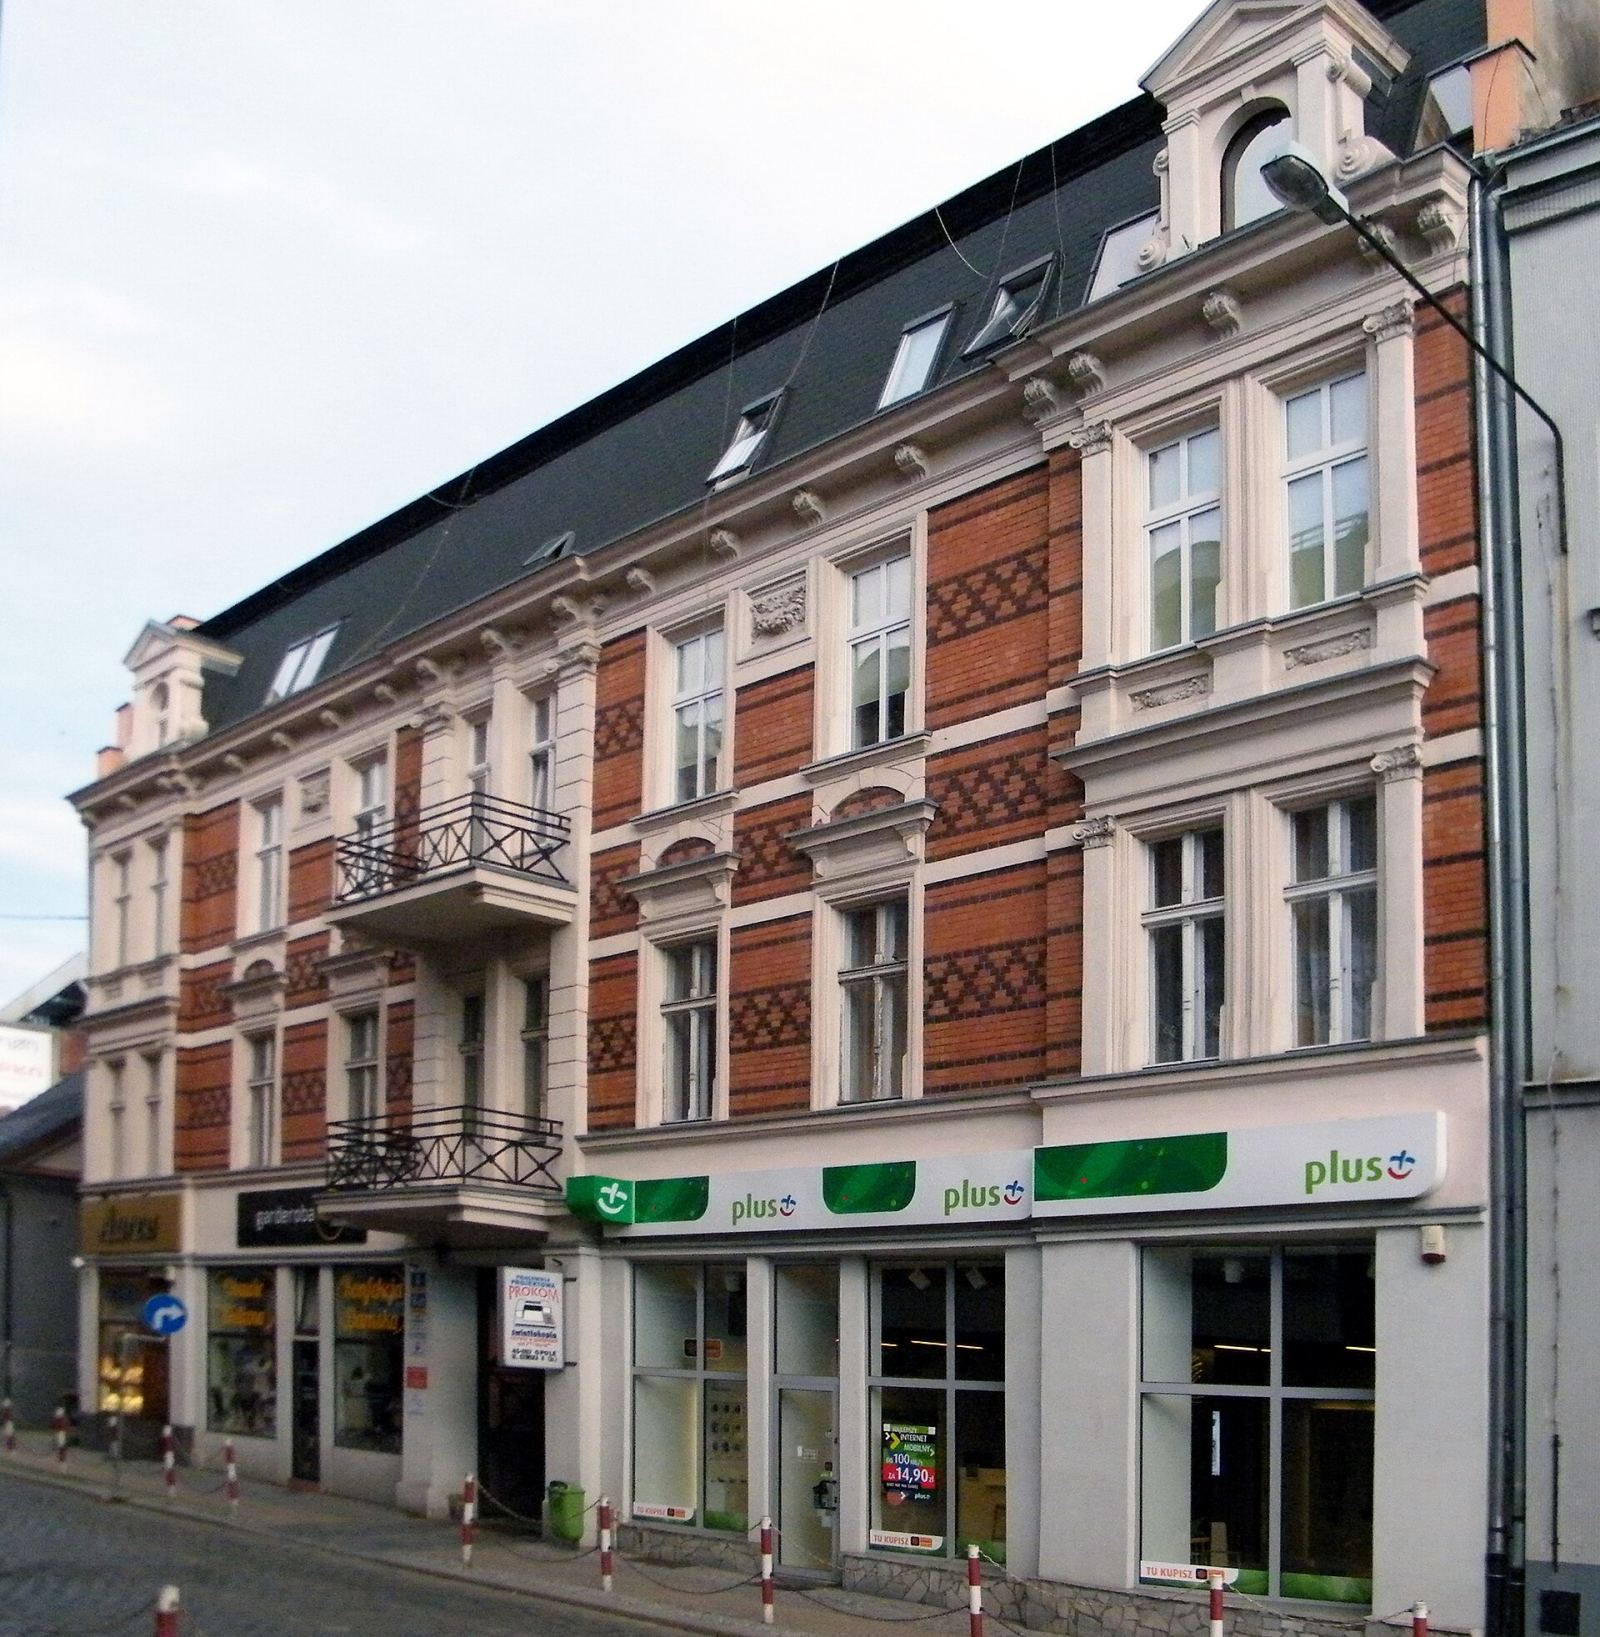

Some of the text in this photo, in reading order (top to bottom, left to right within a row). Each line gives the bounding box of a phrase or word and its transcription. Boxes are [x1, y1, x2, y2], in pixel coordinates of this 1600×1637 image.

[1305, 1149, 1383, 1194] plus
[944, 1179, 1000, 1216] plus
[732, 1193, 777, 1225] plus
[509, 1285, 560, 1303] PROKOM
[900, 1433, 927, 1442] INTERNET
[903, 1444, 930, 1452] MOBILNY
[893, 1453, 910, 1465] 100
[896, 1467, 928, 1483] 14,90
[873, 1534, 909, 1545] TU KUPISZ
[1146, 1566, 1192, 1579] TU KUPISZ
